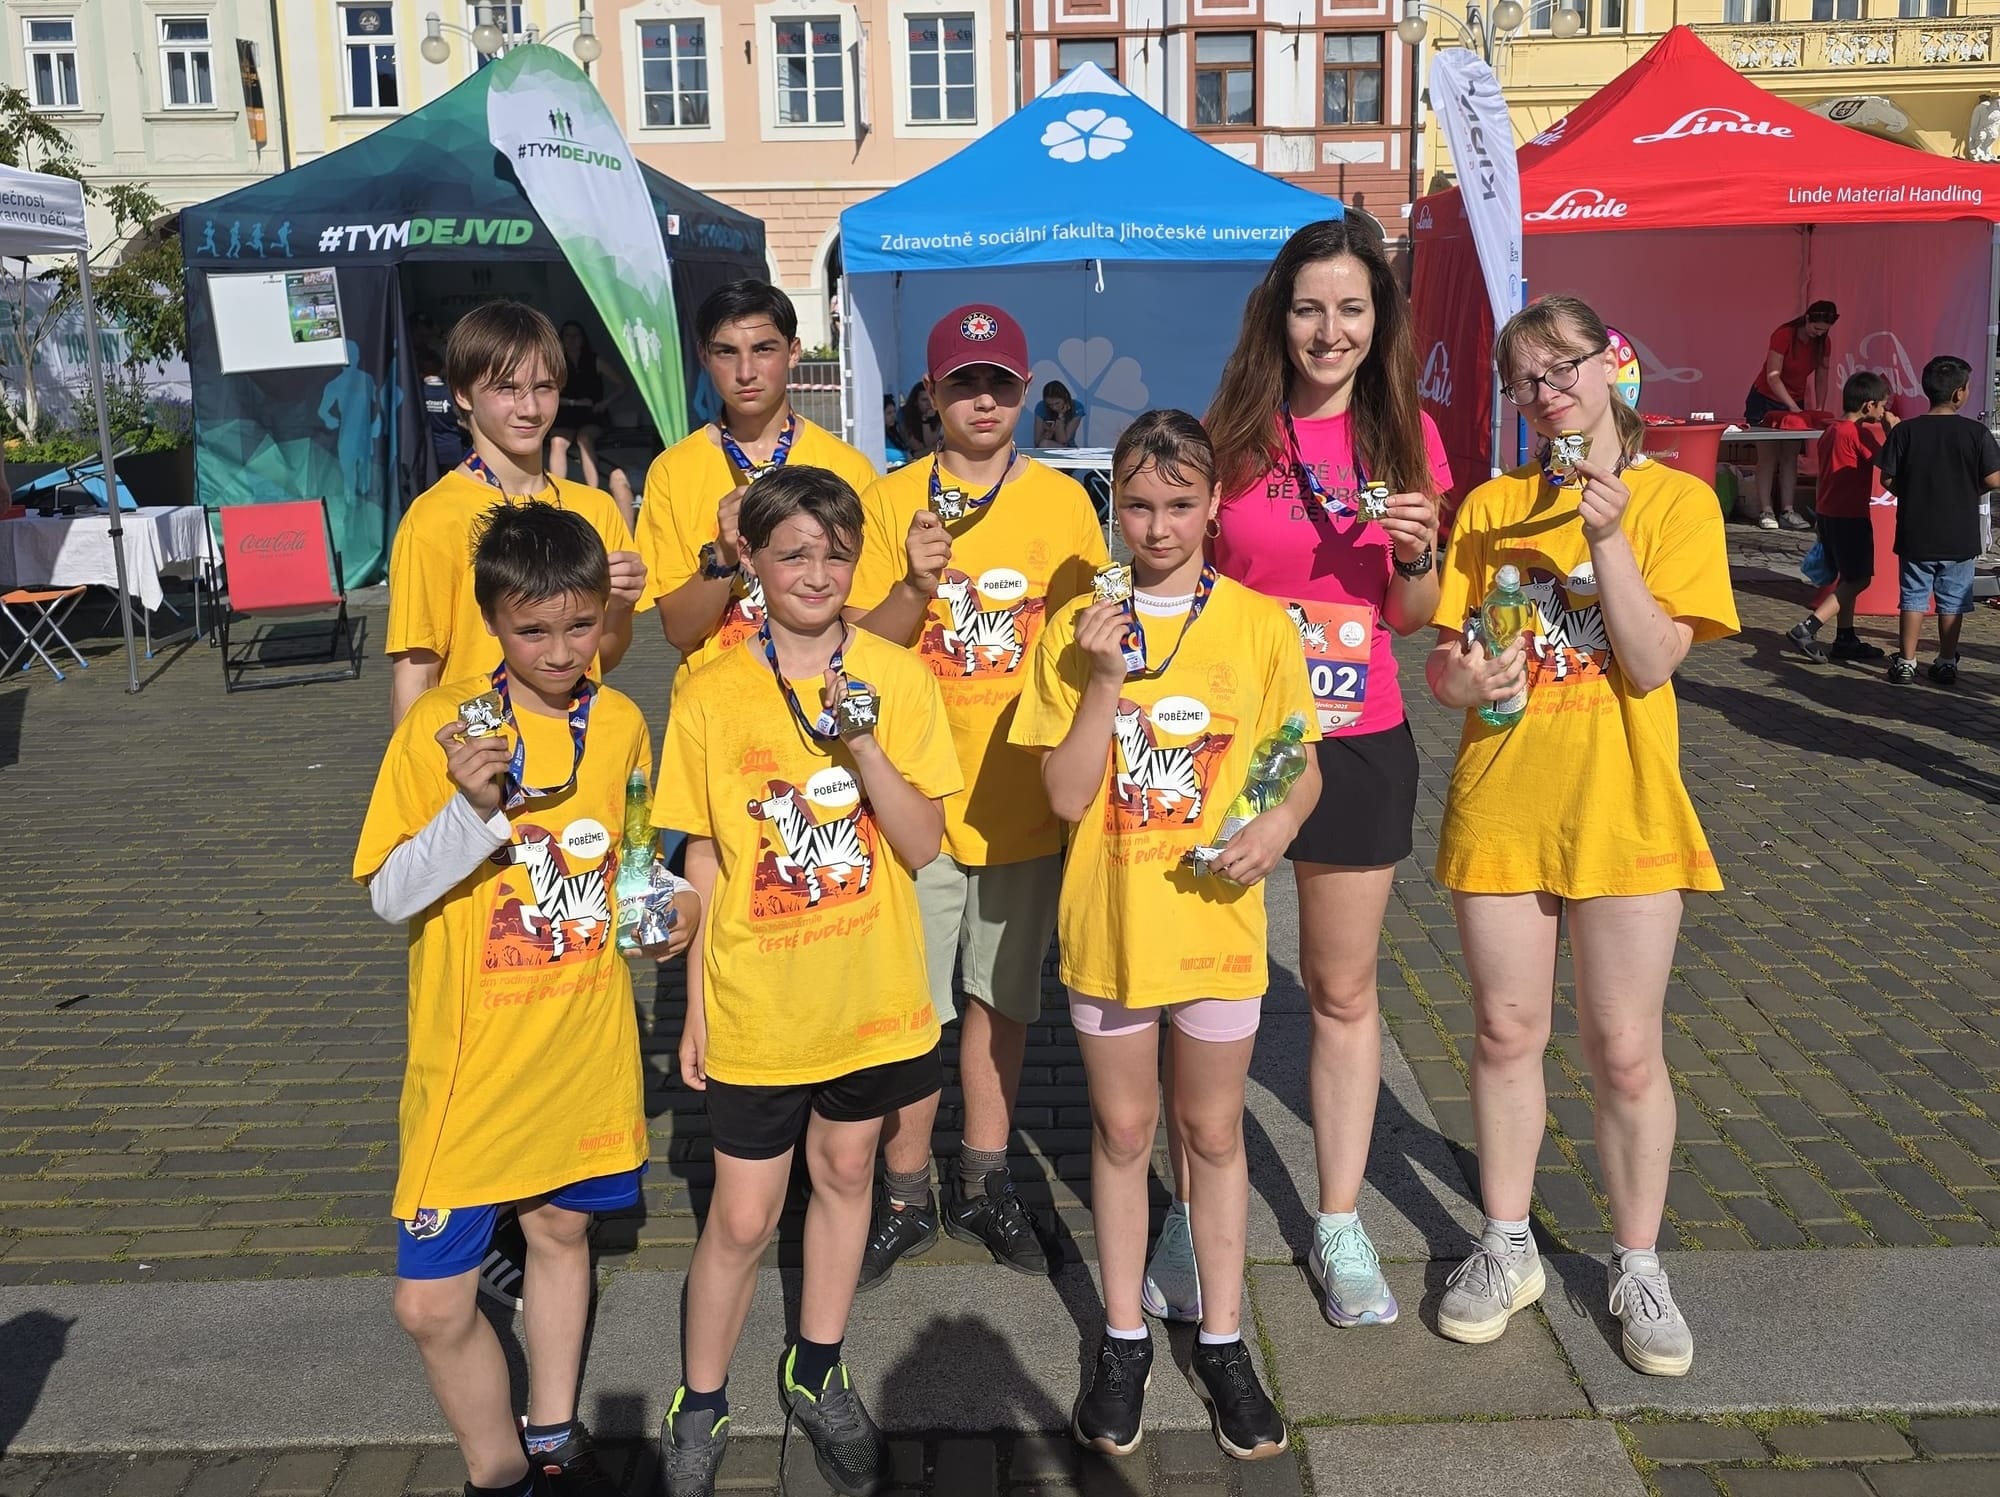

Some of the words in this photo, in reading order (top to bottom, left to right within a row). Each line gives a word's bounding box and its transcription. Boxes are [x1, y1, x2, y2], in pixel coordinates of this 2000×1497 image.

[1633, 107, 1796, 144] Linde
[518, 143, 622, 171] #TYMDEJVID
[1524, 188, 1628, 221] Linde
[1789, 186, 1832, 203] Linde
[1836, 185, 1905, 202] Material
[1909, 185, 1982, 205] Handling
[40, 210, 67, 227] péči
[318, 218, 534, 252] #TYMDEJVID
[880, 232, 973, 250] Zdravotně
[979, 225, 1047, 245] sociální
[1052, 222, 1115, 240] fakulta
[1120, 223, 1206, 242] Jihočeské
[984, 580, 1022, 591] POBĚŽME!
[1158, 709, 1204, 721] POBĚŽME!
[568, 832, 605, 846] POBĚŽME!
